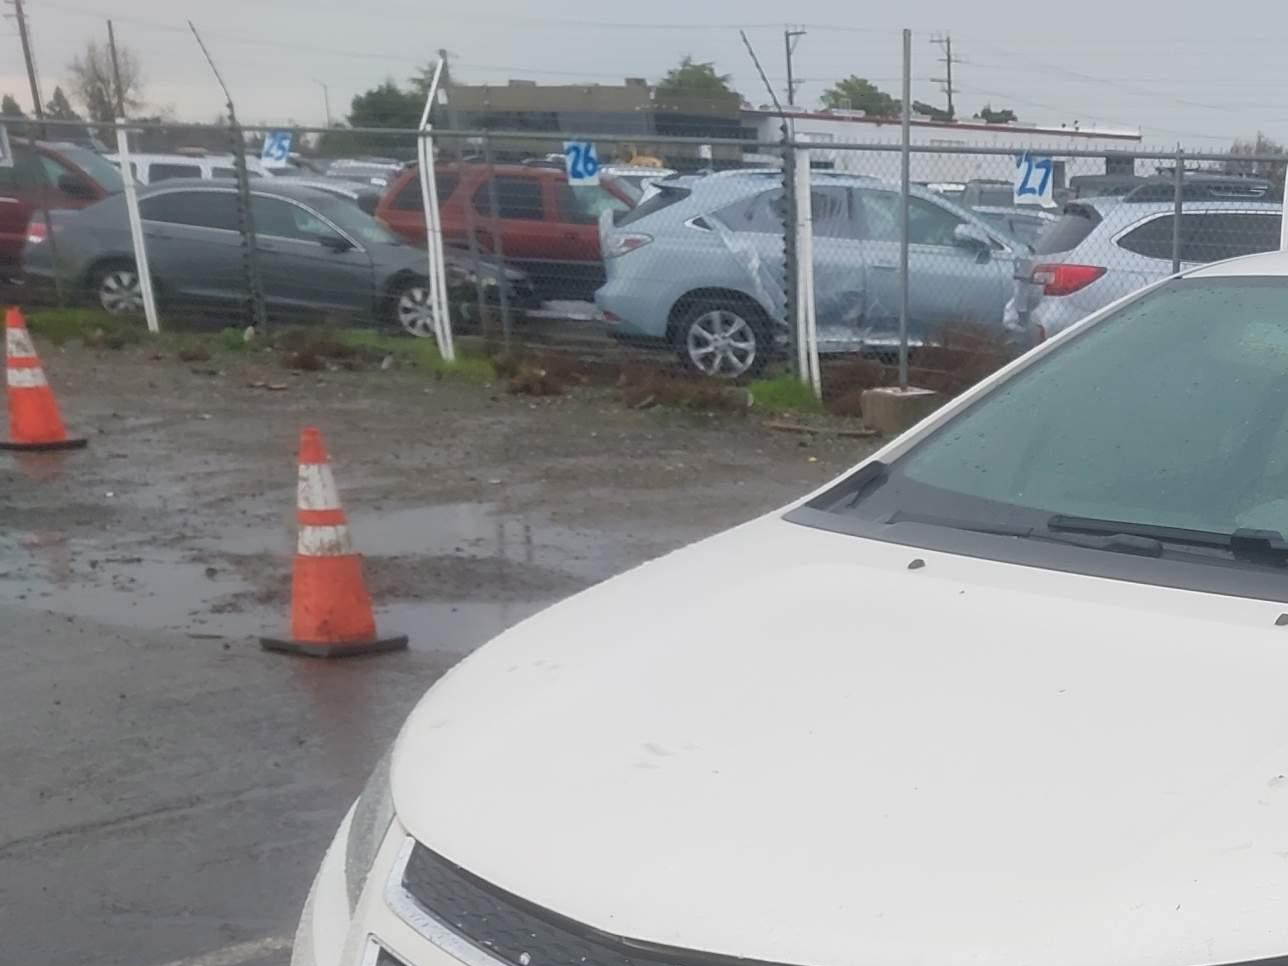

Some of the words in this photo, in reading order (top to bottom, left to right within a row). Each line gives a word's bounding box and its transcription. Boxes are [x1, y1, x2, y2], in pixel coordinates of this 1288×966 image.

[264, 131, 290, 161] 25
[566, 142, 598, 179] 26
[1016, 152, 1052, 197] 27
